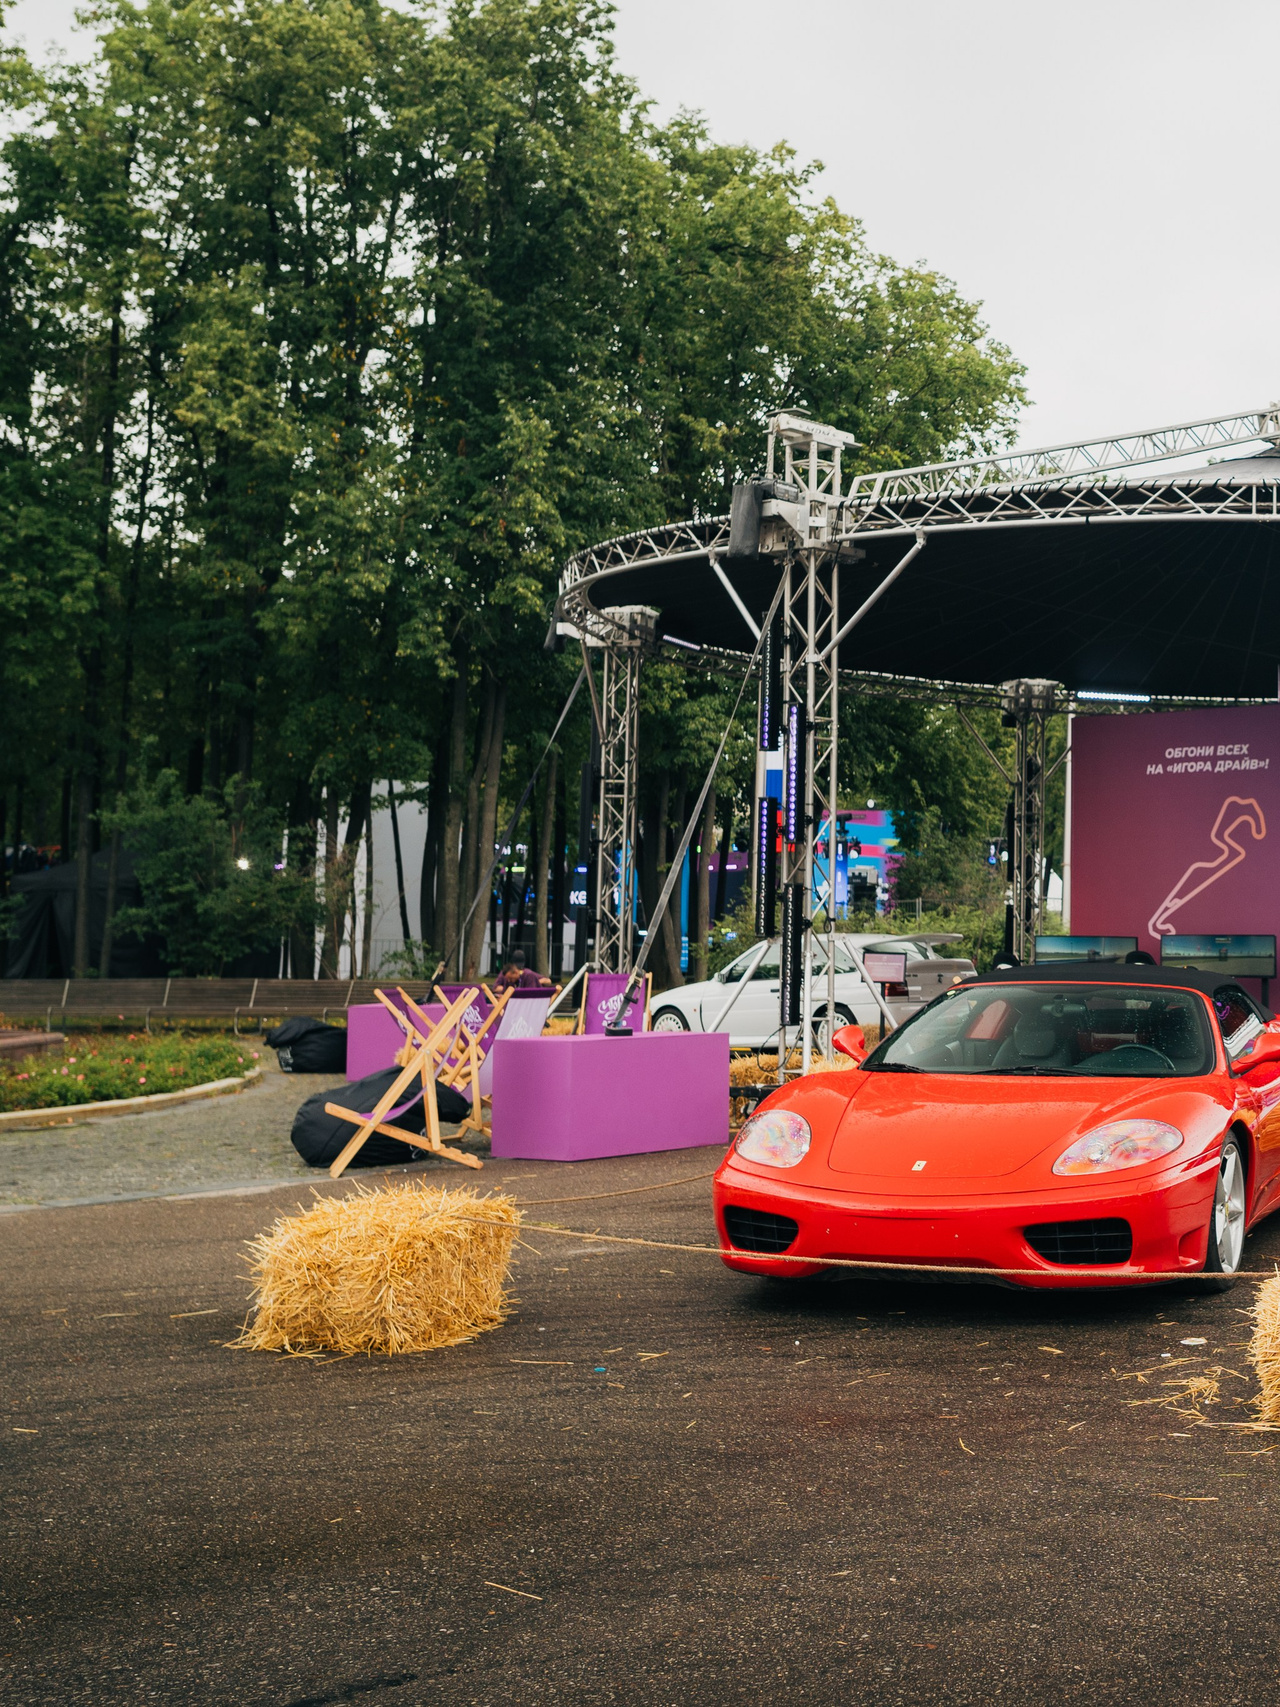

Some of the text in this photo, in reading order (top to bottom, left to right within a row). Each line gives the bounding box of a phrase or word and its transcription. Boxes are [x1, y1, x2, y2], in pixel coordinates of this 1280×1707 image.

[1165, 743, 1250, 759] ОБГОНИ ВСЕХ
[1146, 757, 1270, 775] НА «ИГОРА ДРАЙВ»!
